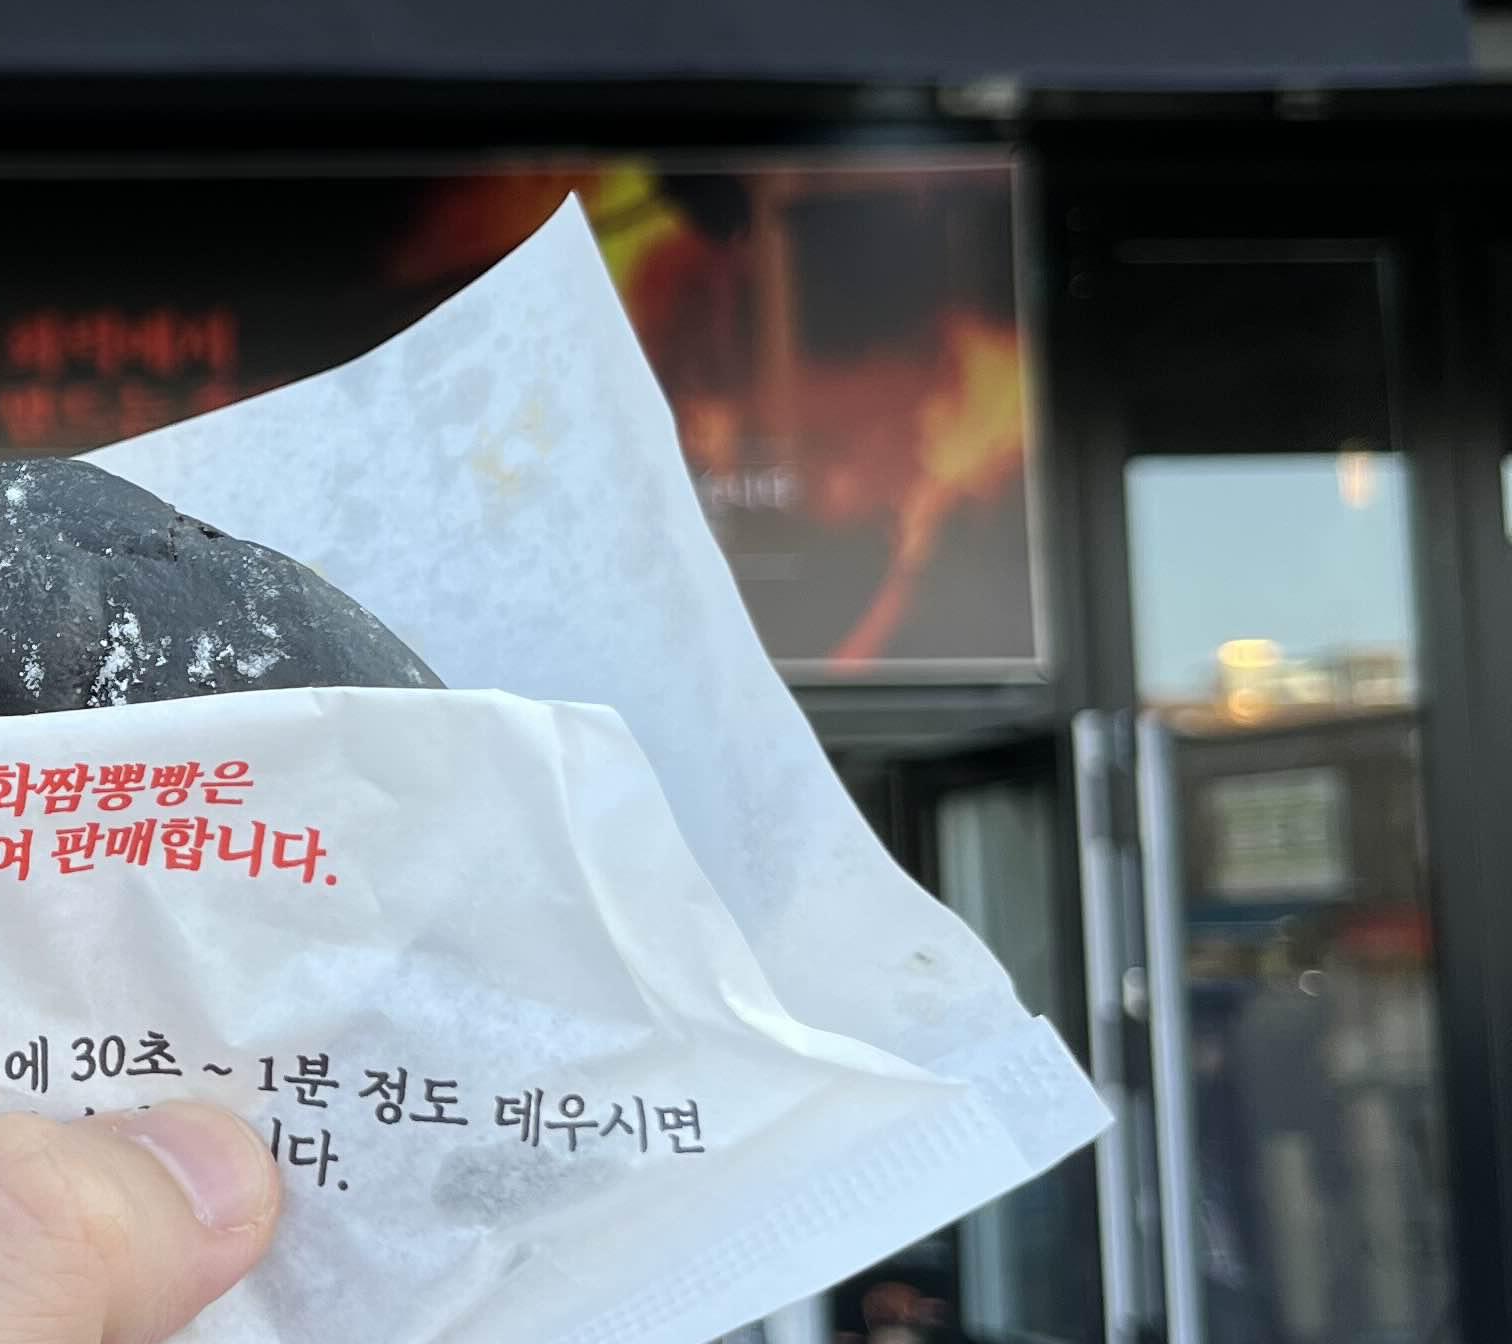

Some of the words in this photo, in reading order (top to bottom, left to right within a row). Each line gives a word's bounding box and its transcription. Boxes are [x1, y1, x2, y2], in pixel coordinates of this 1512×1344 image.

[50, 815, 339, 887] 판매합니다.
[70, 1029, 184, 1083] 30초
[256, 1052, 341, 1109] 1분
[358, 1066, 469, 1127] 정도
[495, 1088, 706, 1155] 데우시면
